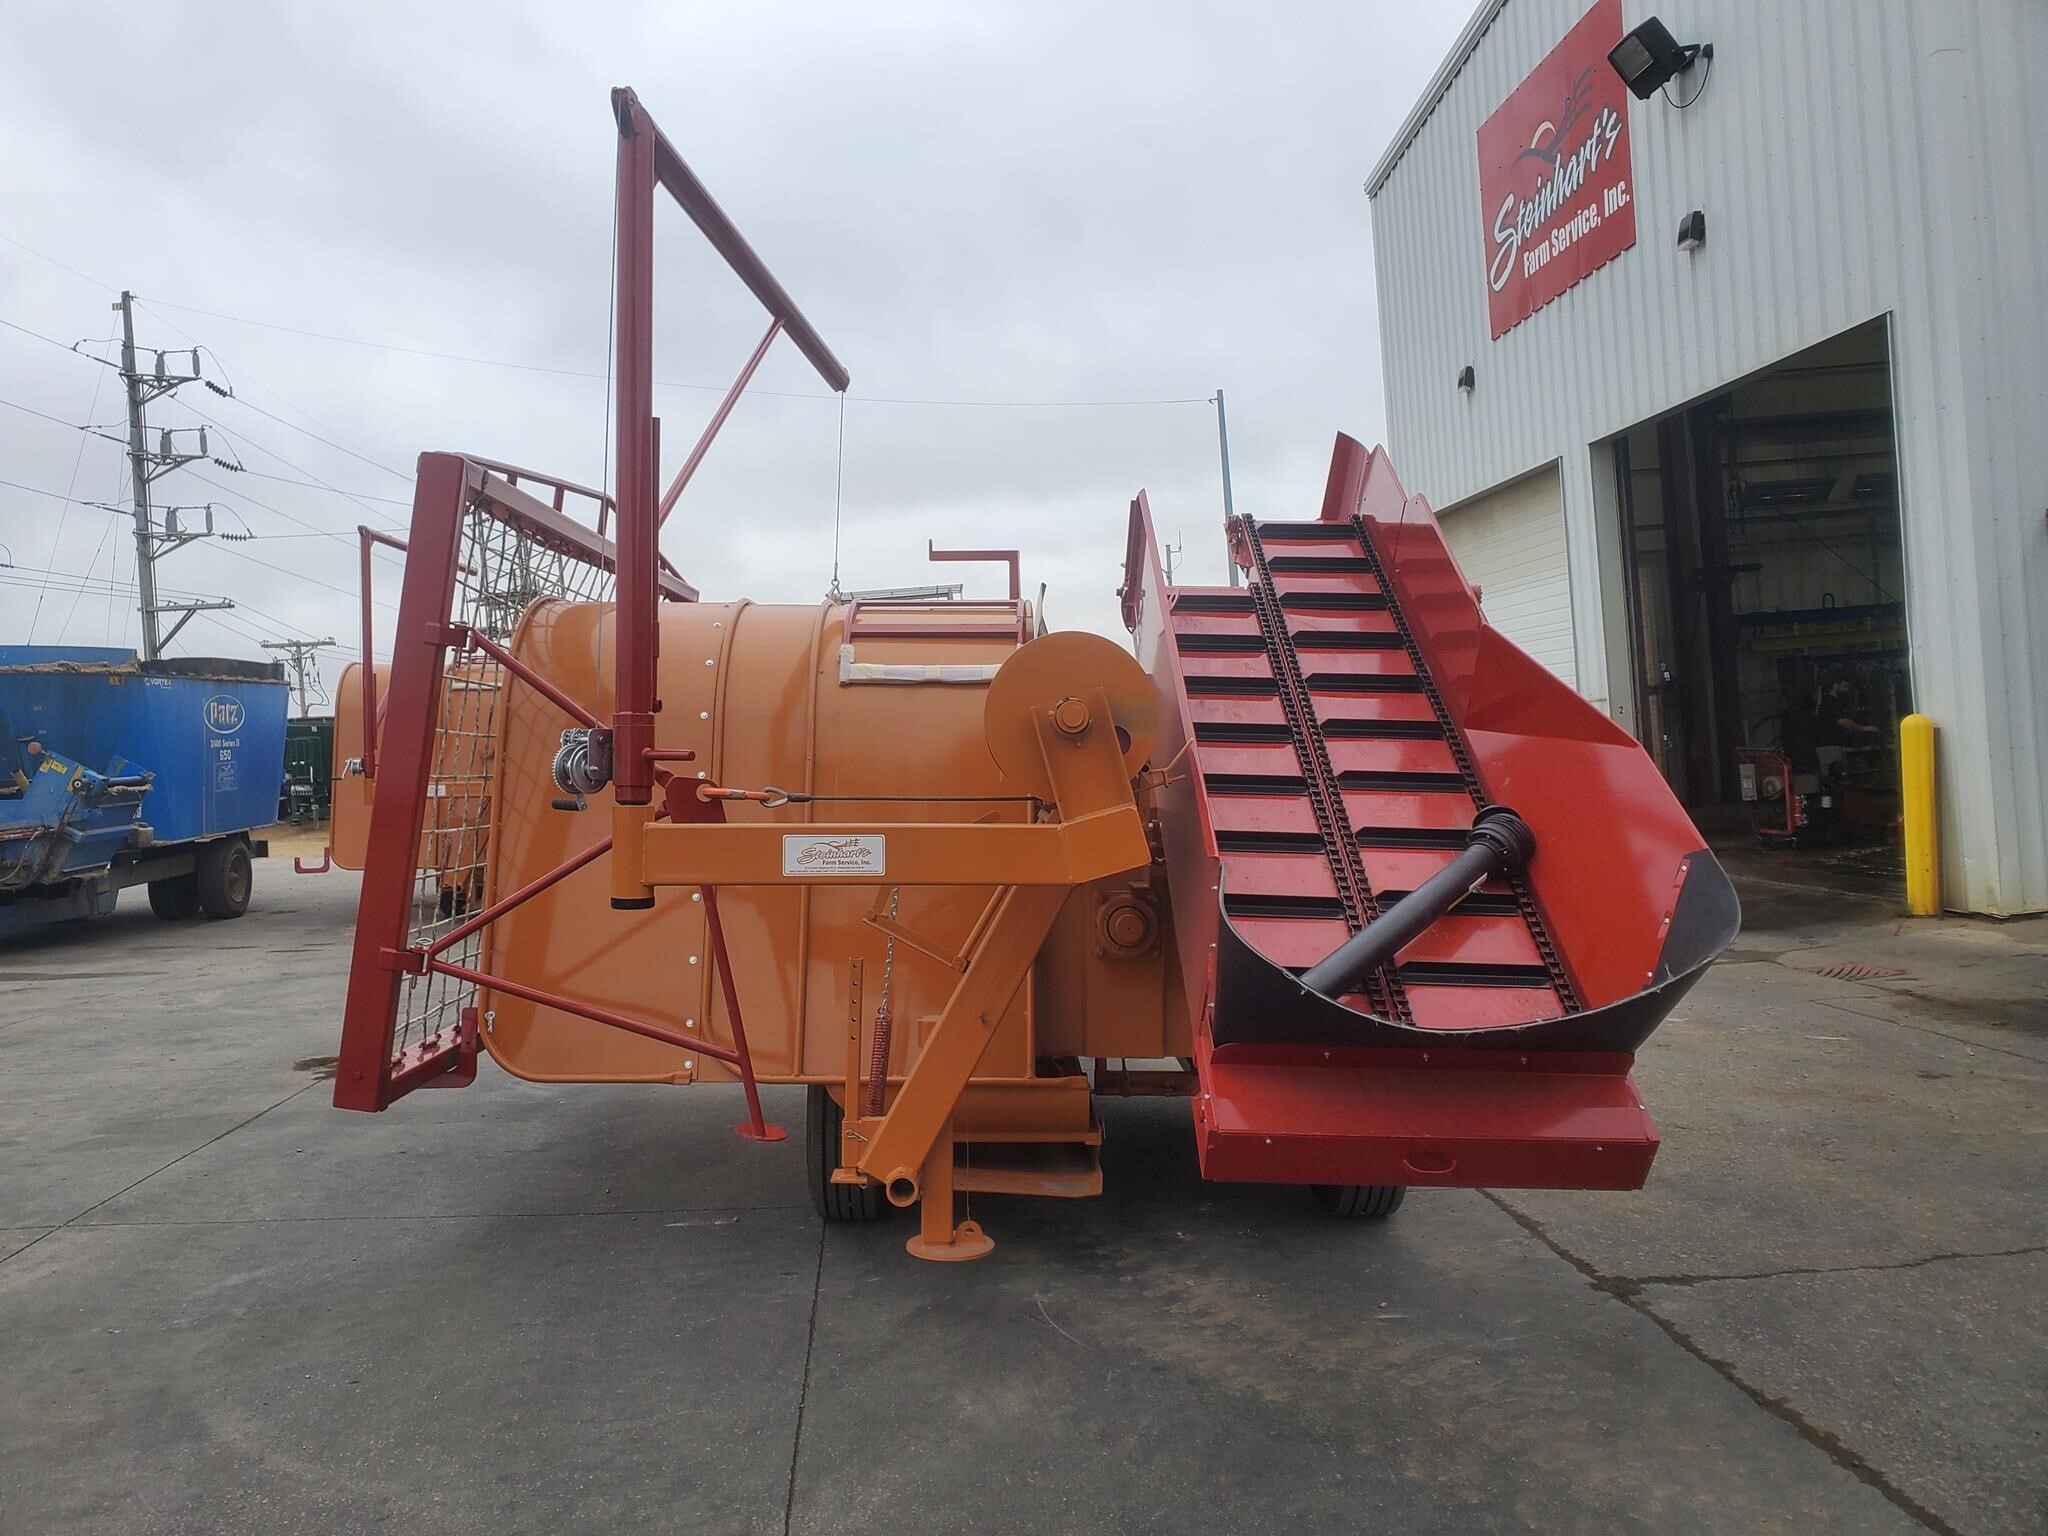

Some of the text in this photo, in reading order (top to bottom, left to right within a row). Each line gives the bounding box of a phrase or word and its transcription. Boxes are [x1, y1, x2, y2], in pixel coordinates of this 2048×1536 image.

[1490, 106, 1622, 292] Steinhart's
[1523, 180, 1630, 279] Farm Service, Inc.
[1618, 705, 1624, 715] 2
[220, 749, 231, 761] 650
[796, 847, 872, 865] Steinhart's
